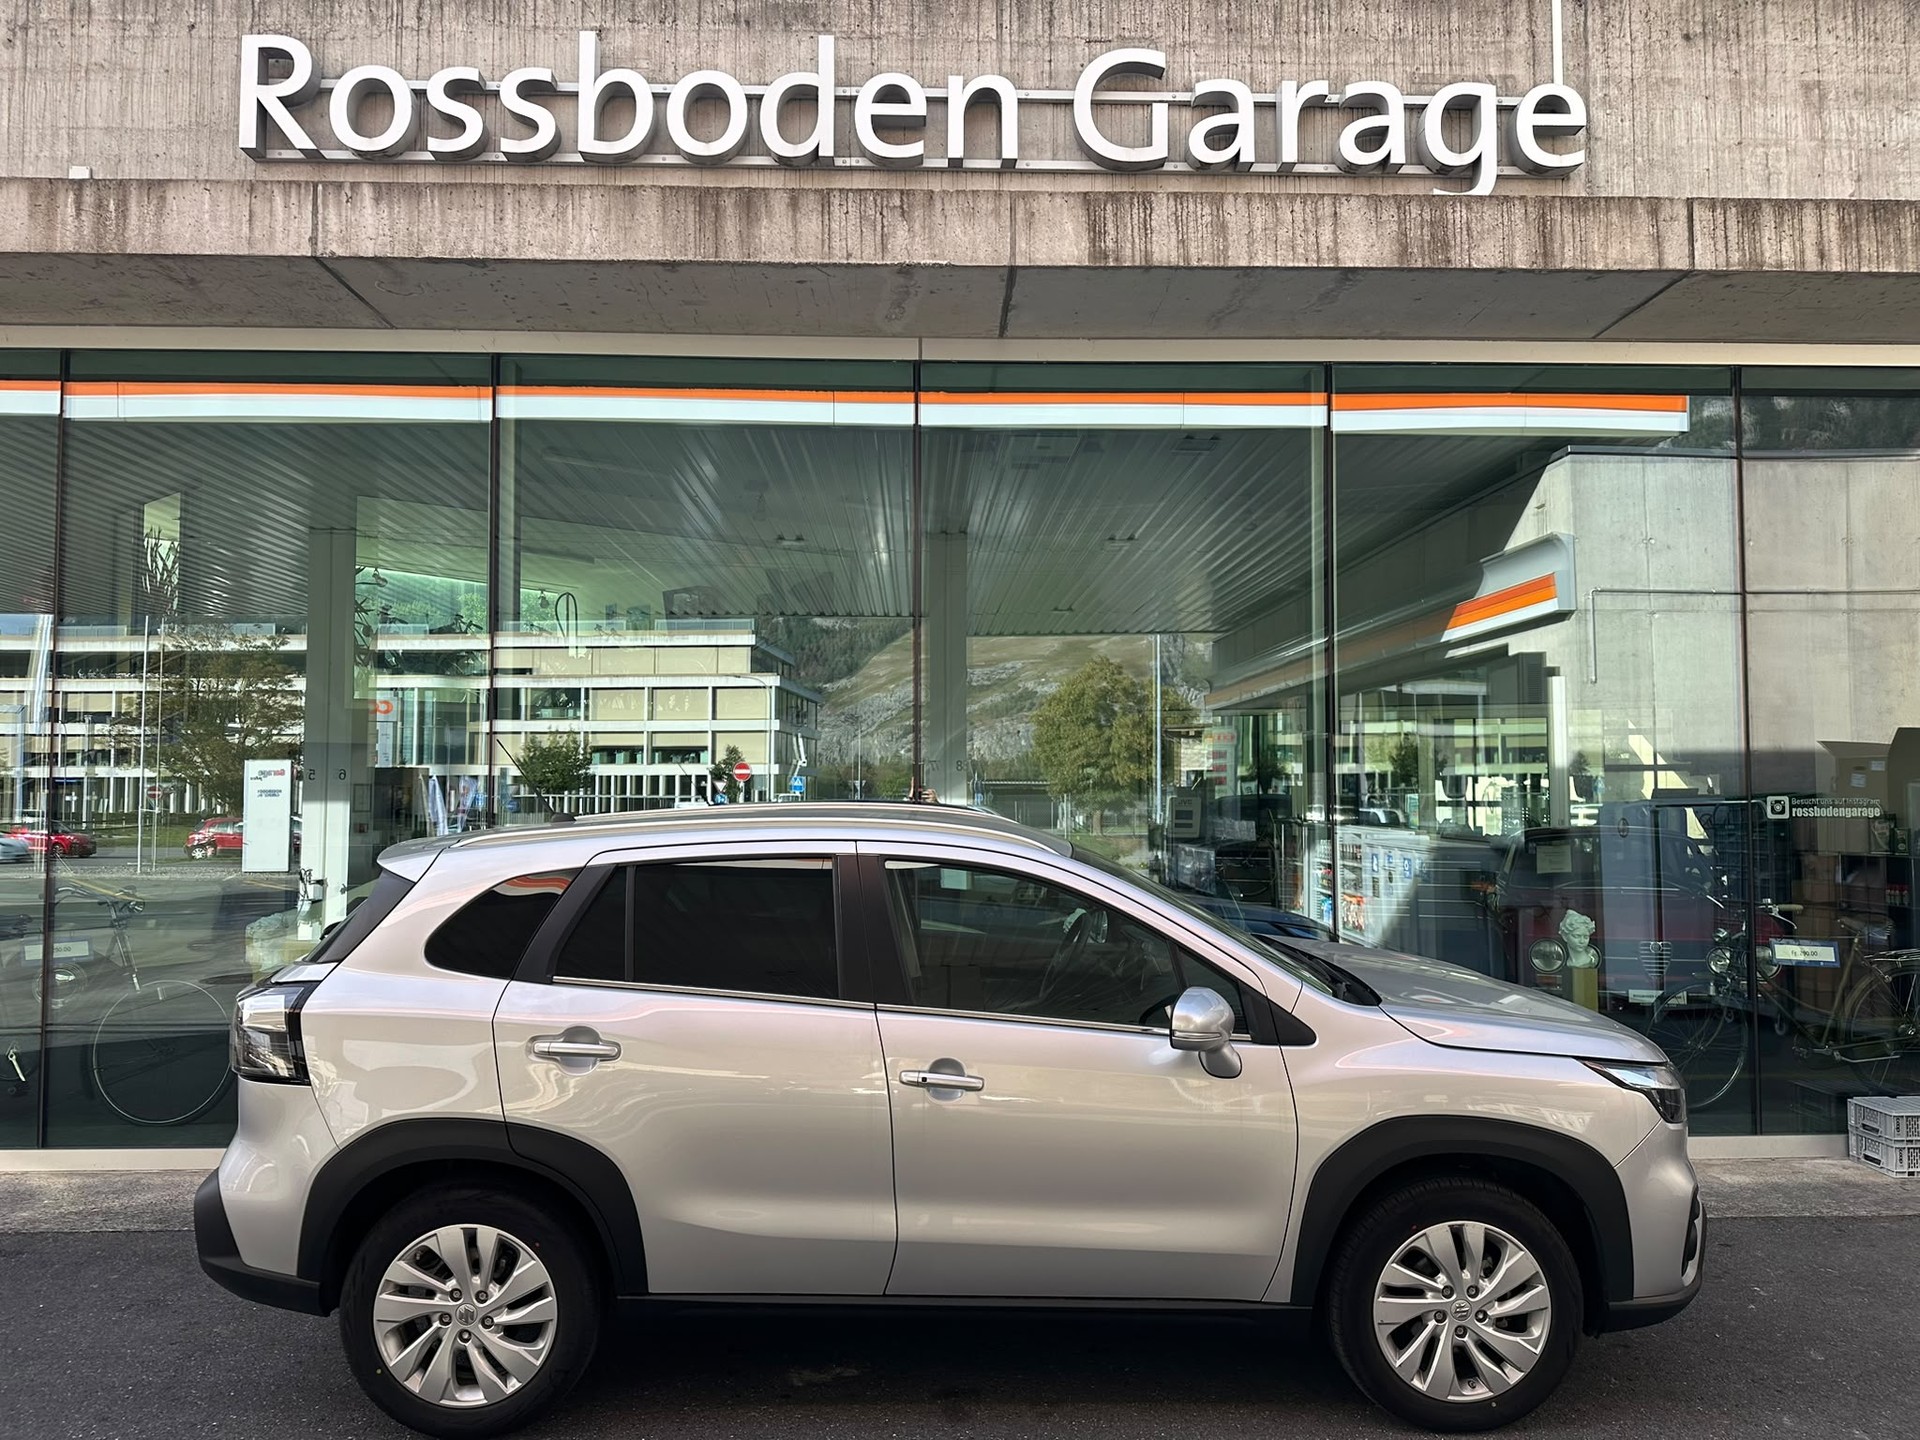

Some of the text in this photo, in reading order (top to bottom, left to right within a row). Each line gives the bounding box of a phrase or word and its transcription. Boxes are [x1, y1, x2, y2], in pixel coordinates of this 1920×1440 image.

[238, 30, 1586, 196] Rossboden Garage
[1847, 798, 1881, 806] Instagram
[1792, 806, 1881, 818] rossbodengarage
